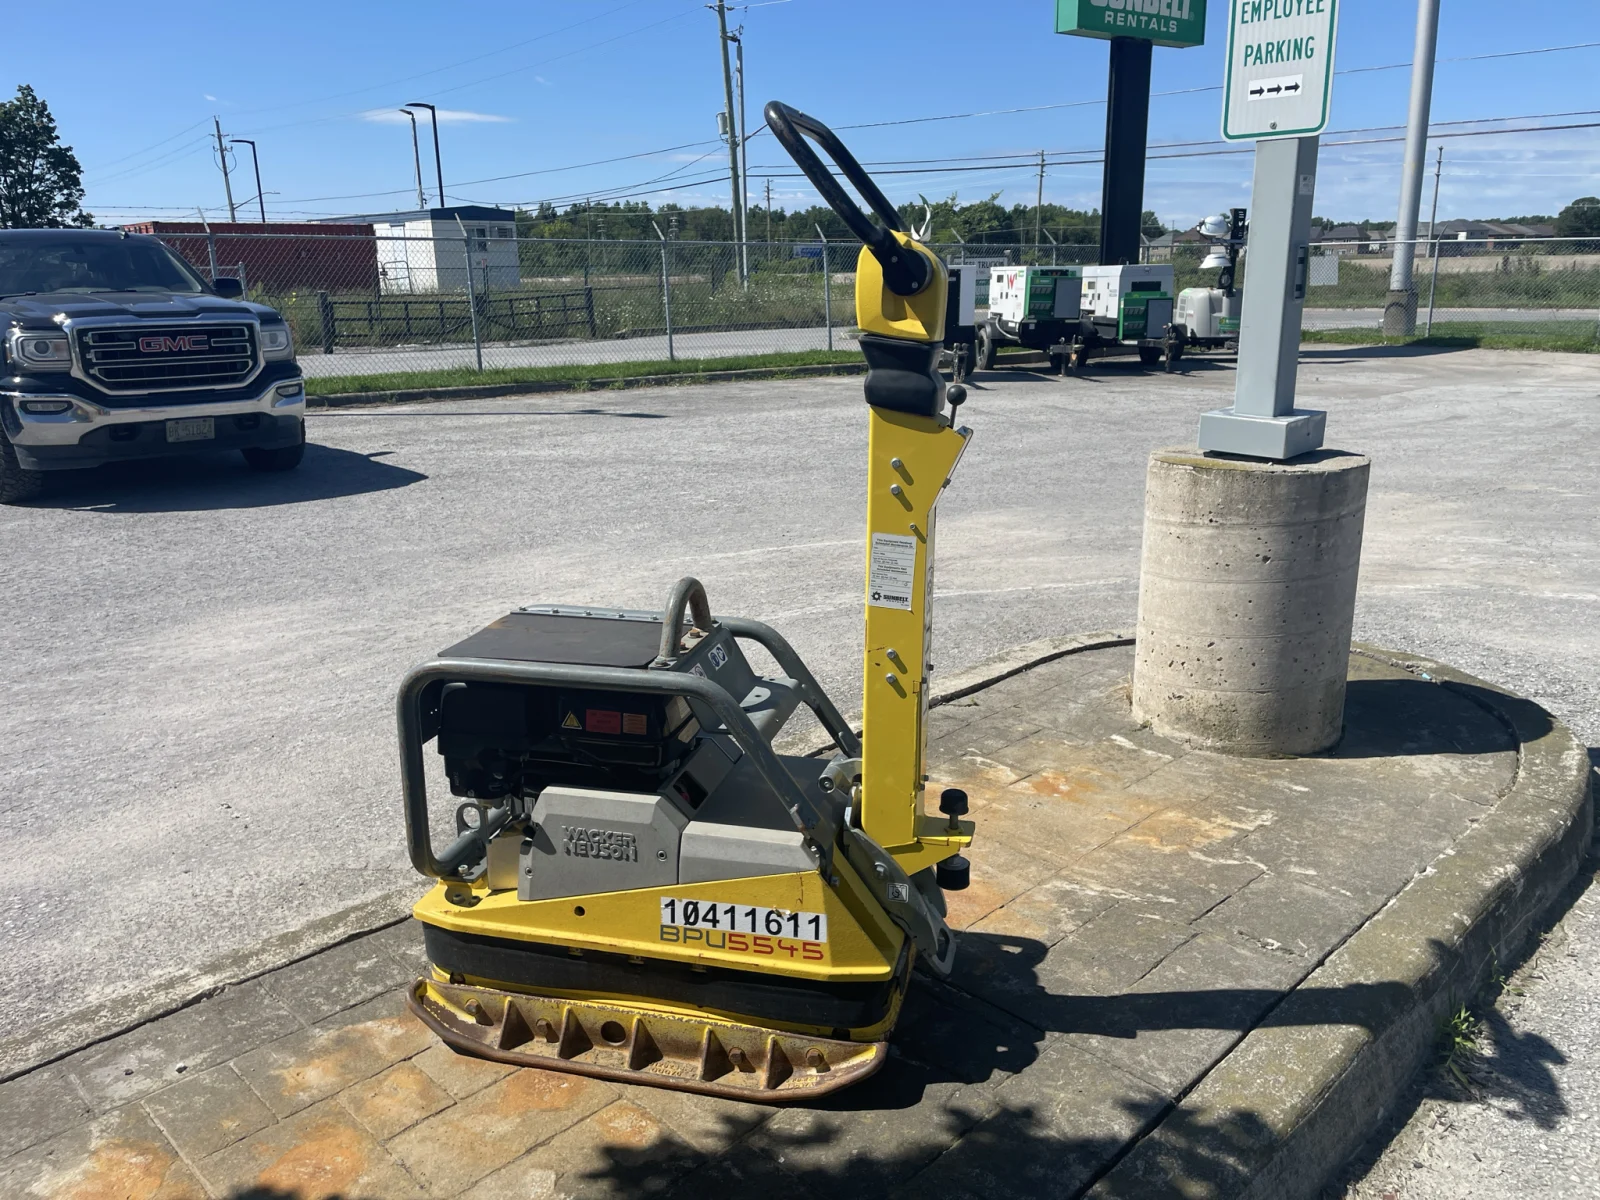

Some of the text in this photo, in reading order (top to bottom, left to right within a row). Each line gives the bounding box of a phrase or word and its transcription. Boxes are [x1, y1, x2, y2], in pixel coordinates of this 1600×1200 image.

[1090, 0, 1190, 19] BELT
[1241, 0, 1325, 24] EMPLOYEE
[1104, 11, 1178, 33] RENTALS
[1243, 36, 1315, 67] PARKING
[139, 335, 209, 352] GMC
[561, 825, 637, 846] WACKER
[562, 839, 638, 862] NEUSON
[660, 924, 824, 960] BPU5545
